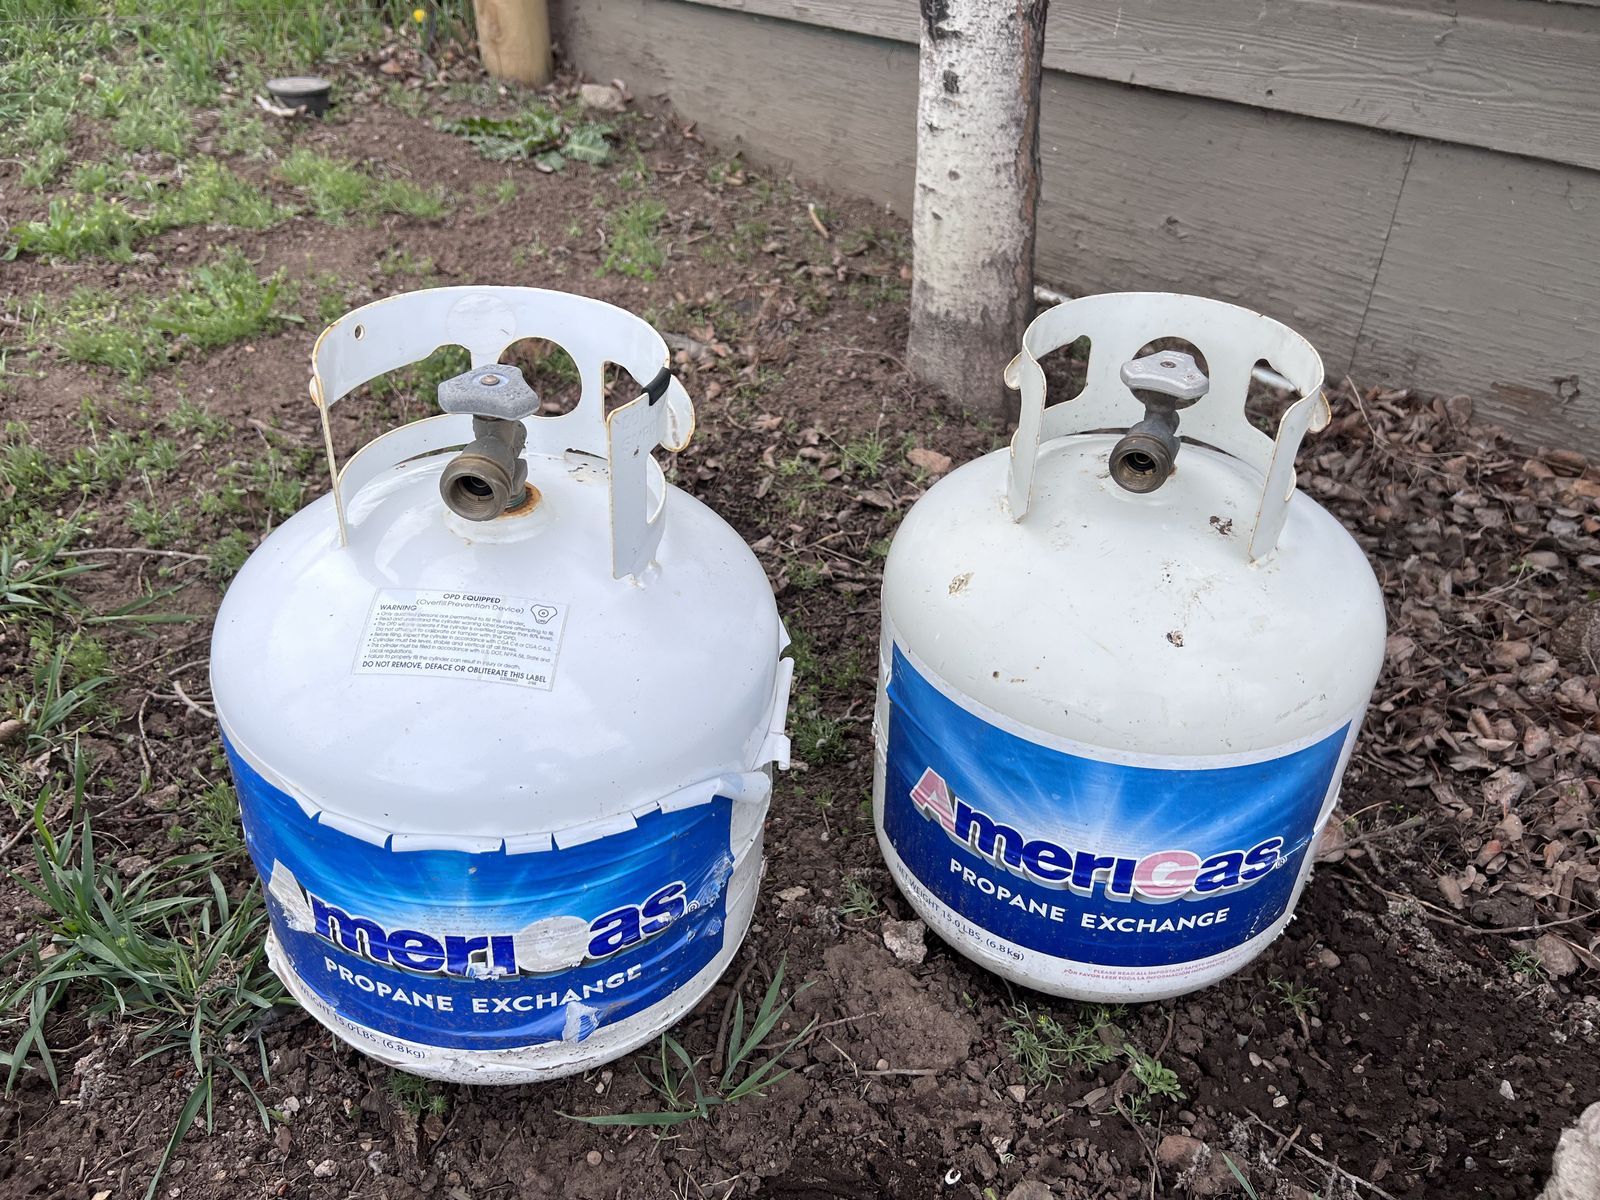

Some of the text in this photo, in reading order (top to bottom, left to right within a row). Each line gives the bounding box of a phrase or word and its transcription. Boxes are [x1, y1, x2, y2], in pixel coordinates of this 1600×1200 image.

[448, 601, 490, 609] Prevention
[493, 605, 524, 614] Device)
[463, 595, 500, 604] EQUIPPED
[514, 626, 541, 634] attempting
[391, 661, 422, 670] REMOVE,
[425, 662, 452, 671] DEFACE
[468, 666, 508, 677] OBLITERATE
[510, 671, 524, 679] THIS
[526, 673, 546, 683] LABEL
[896, 863, 908, 880] NET
[908, 880, 939, 911] WEIGHT
[940, 910, 961, 929] 15.0
[950, 857, 1231, 934] PROPANE EXCHANGE
[1148, 967, 1184, 975] IMPORTANT
[1185, 963, 1204, 971] SAFETY
[324, 957, 643, 1015] PROPANE EXCHANGE
